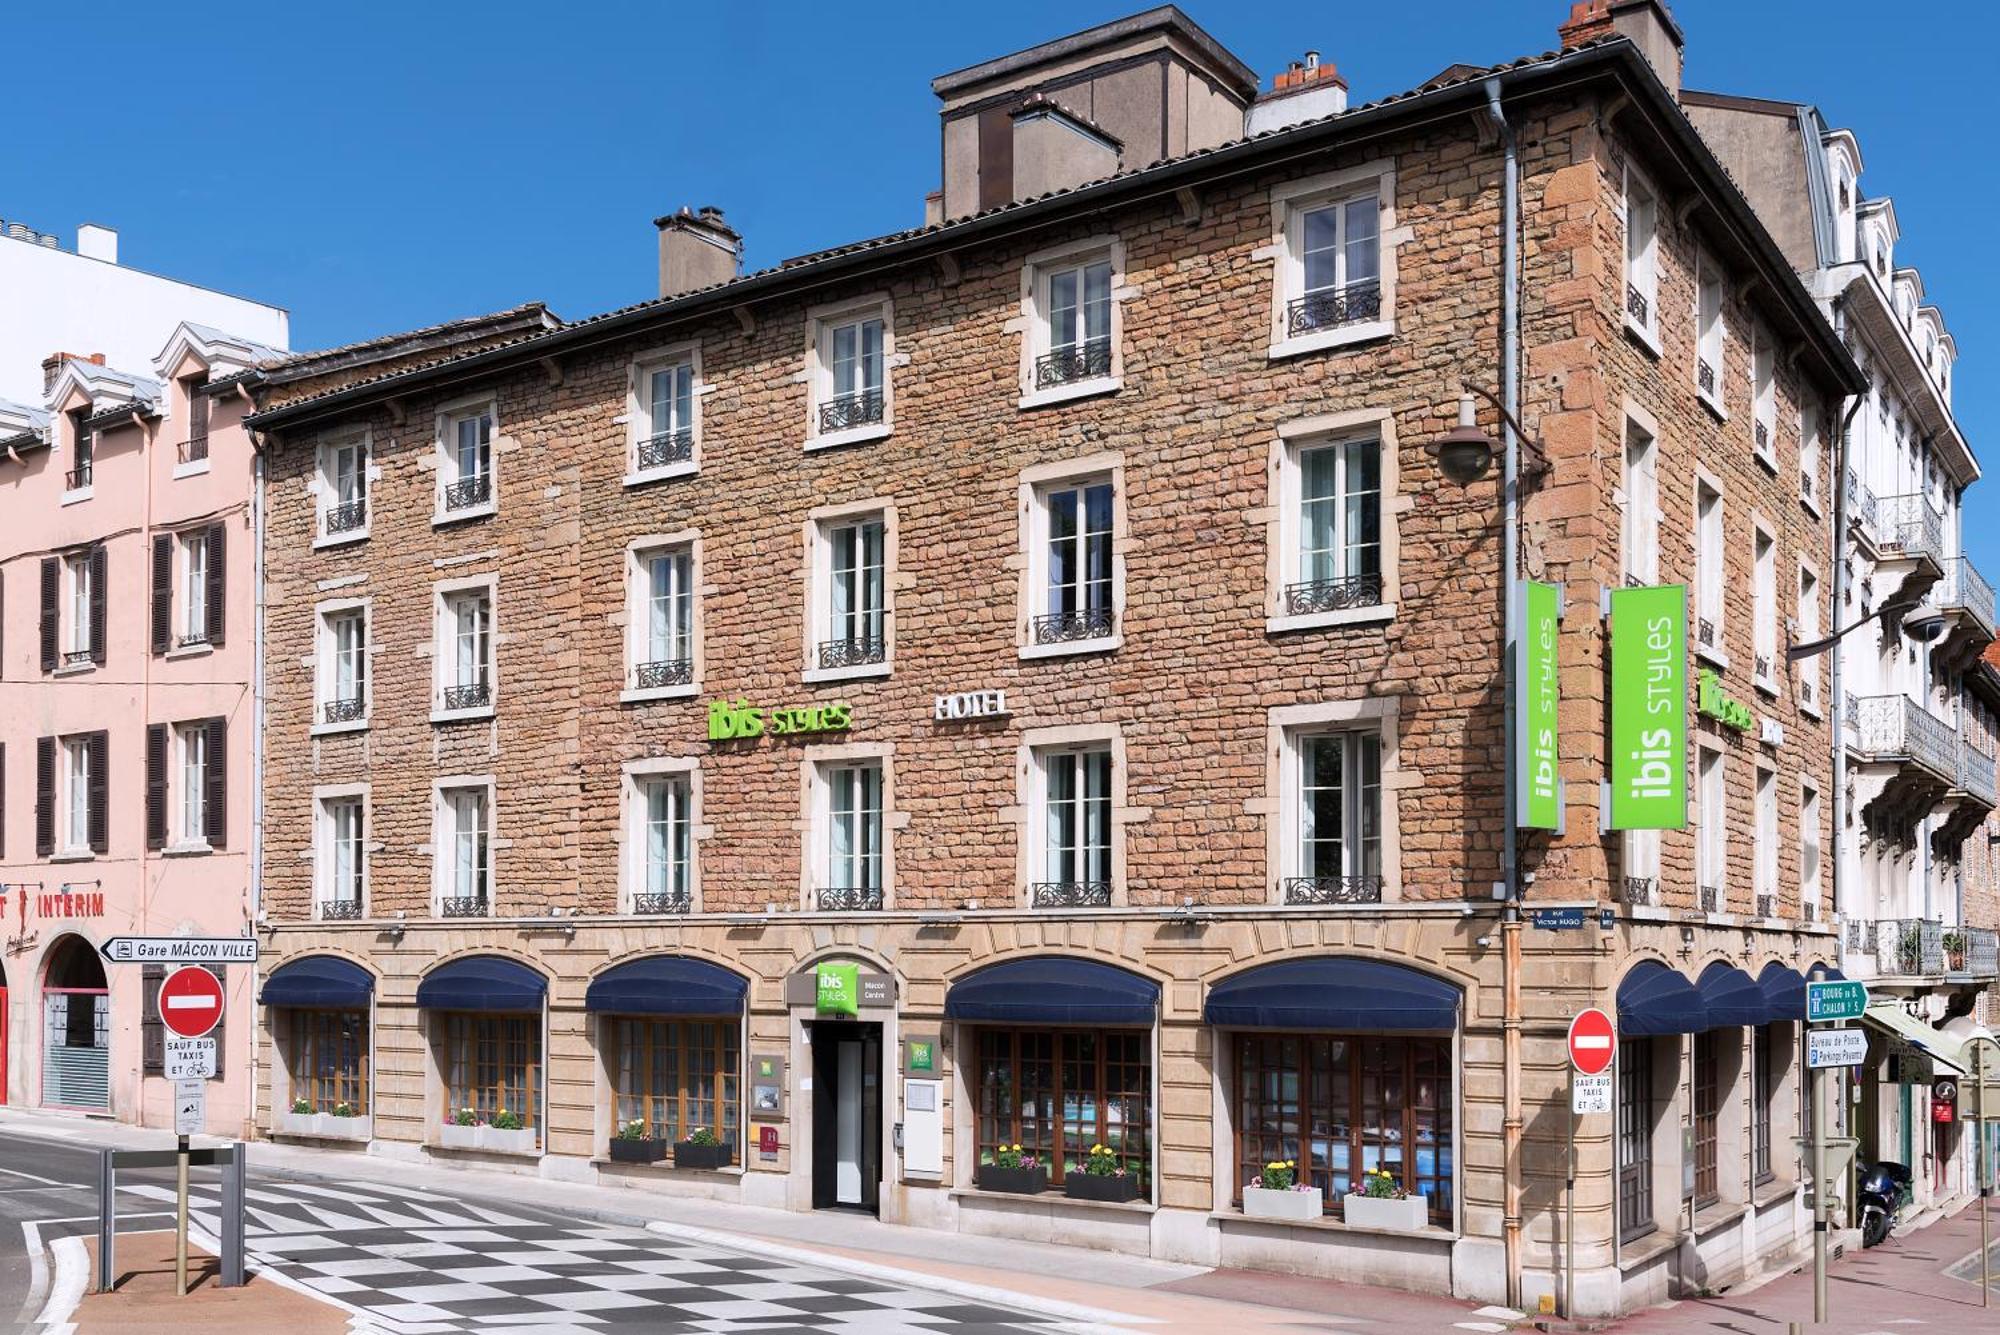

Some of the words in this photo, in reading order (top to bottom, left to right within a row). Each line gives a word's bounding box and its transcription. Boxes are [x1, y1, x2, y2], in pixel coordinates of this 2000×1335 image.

[935, 689, 1013, 720] HOTEL
[707, 698, 763, 740] ibis
[1535, 729, 1553, 798] ibis
[1631, 728, 1672, 799] ibis
[38, 893, 104, 918] INTERIM
[138, 943, 167, 956] Gare
[171, 941, 218, 957] MÂCON
[222, 944, 254, 957] VILLE
[820, 972, 843, 989] ibis
[1822, 987, 1843, 1000] BOURG
[1823, 1002, 1846, 1014] CHALON
[167, 1041, 193, 1051] SAUF
[196, 1040, 215, 1049] BUS
[1811, 1036, 1832, 1048] Bureau
[1834, 1036, 1842, 1047] de
[1843, 1034, 1860, 1046] Poste
[178, 1051, 204, 1060] TAXIS
[1819, 1051, 1841, 1064] Parkings
[171, 1066, 183, 1074] ET
[1575, 1079, 1594, 1087] SAUF
[1597, 1078, 1610, 1086] BUS
[1583, 1088, 1603, 1096] TAXIS
[1578, 1101, 1588, 1109] ET
